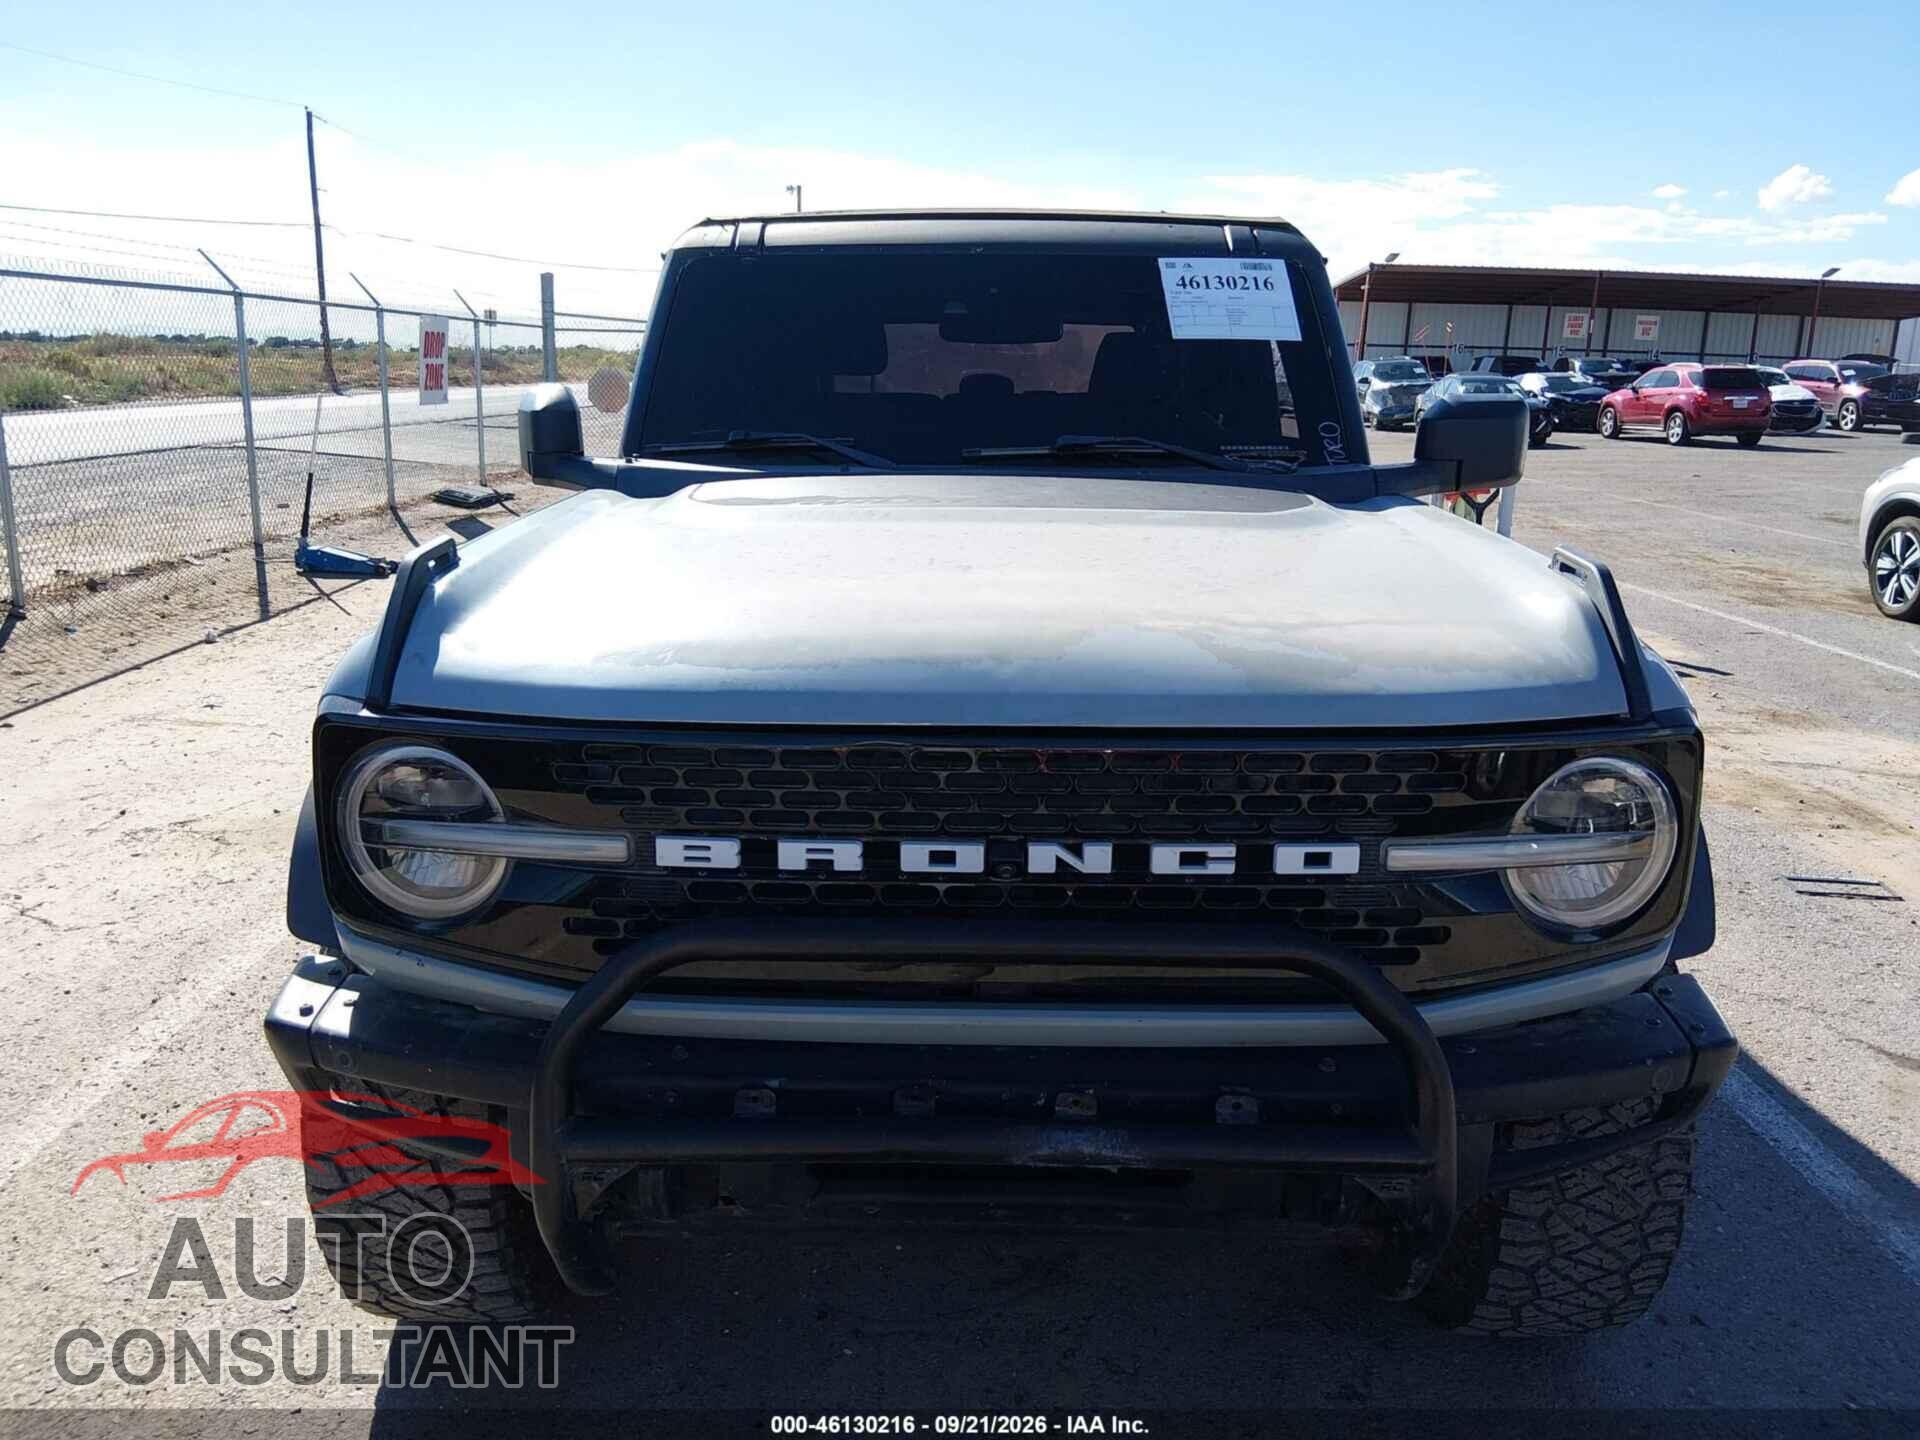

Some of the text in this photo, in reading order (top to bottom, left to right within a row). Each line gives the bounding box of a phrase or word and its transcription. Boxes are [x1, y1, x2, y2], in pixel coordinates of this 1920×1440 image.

[1176, 275, 1274, 291] 46130216
[423, 331, 445, 359] DROP
[423, 364, 444, 391] ZONE
[655, 835, 1360, 875] BRONCO
